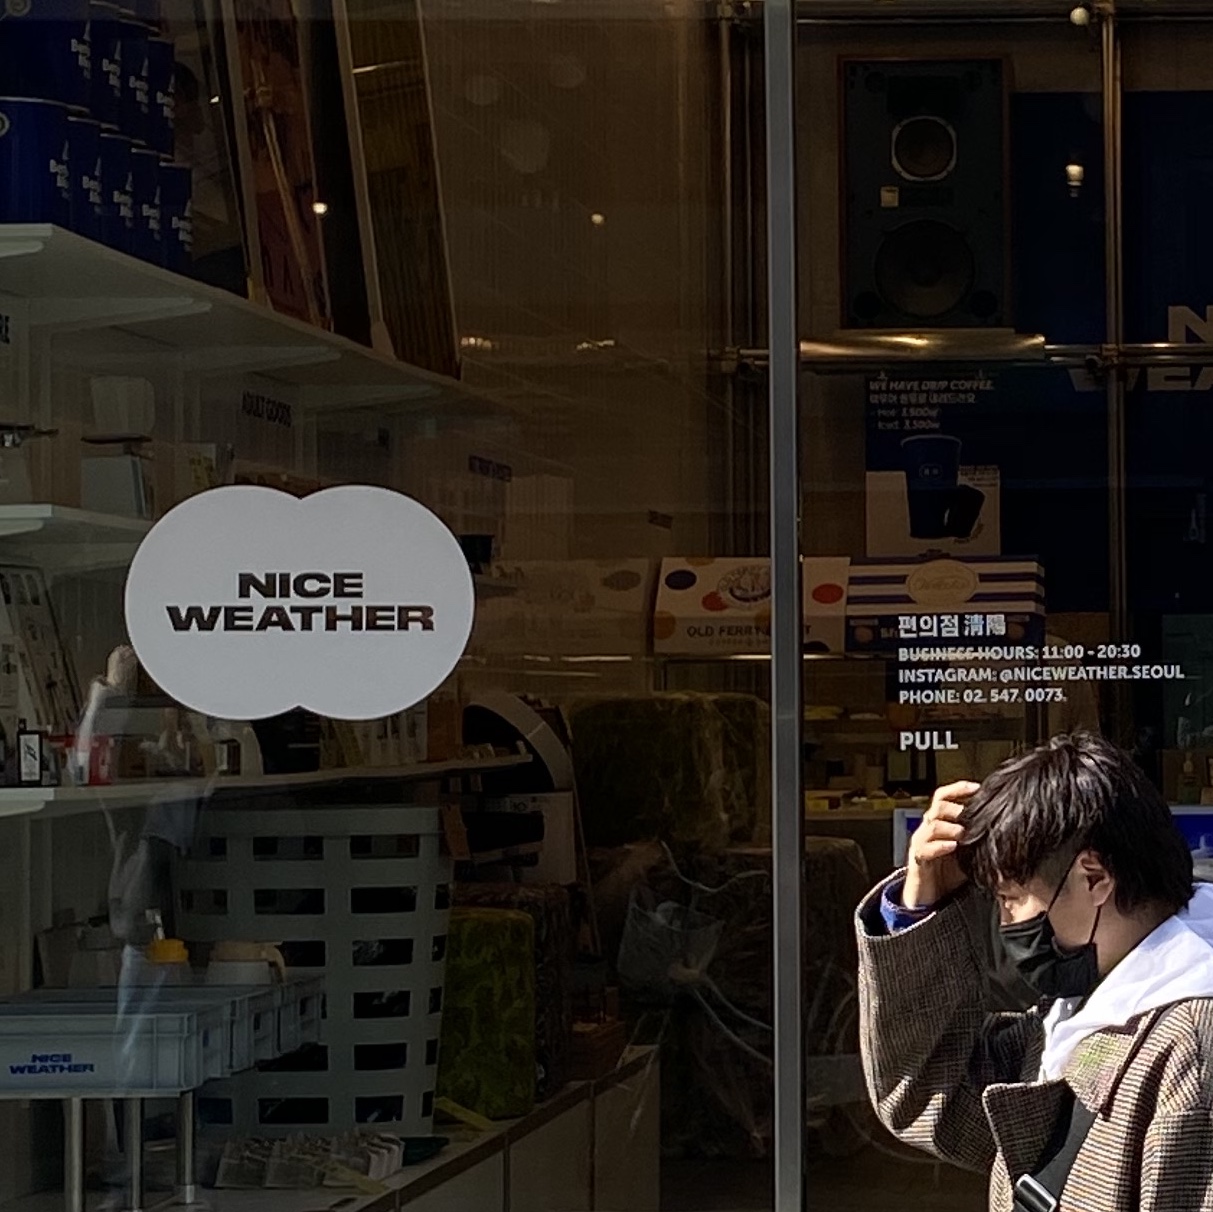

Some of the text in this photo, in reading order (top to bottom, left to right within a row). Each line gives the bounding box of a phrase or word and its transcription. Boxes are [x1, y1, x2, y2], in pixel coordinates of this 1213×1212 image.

[238, 572, 363, 598] NICE
[166, 605, 434, 631] WEATHER
[898, 614, 960, 639] 편의점
[687, 625, 714, 638] OLD
[898, 646, 975, 661] BUSINESS
[977, 645, 1039, 660] HOURS:
[1042, 644, 1084, 659] 11:00
[1097, 643, 1142, 658] 20:30
[898, 664, 1186, 683] INSTAGRAM: @NICEWEATHER.SEOUL
[899, 690, 960, 704] PHONE:
[899, 730, 959, 751] PULL
[31, 1053, 72, 1063] NICE
[9, 1063, 95, 1074] WEATHER
